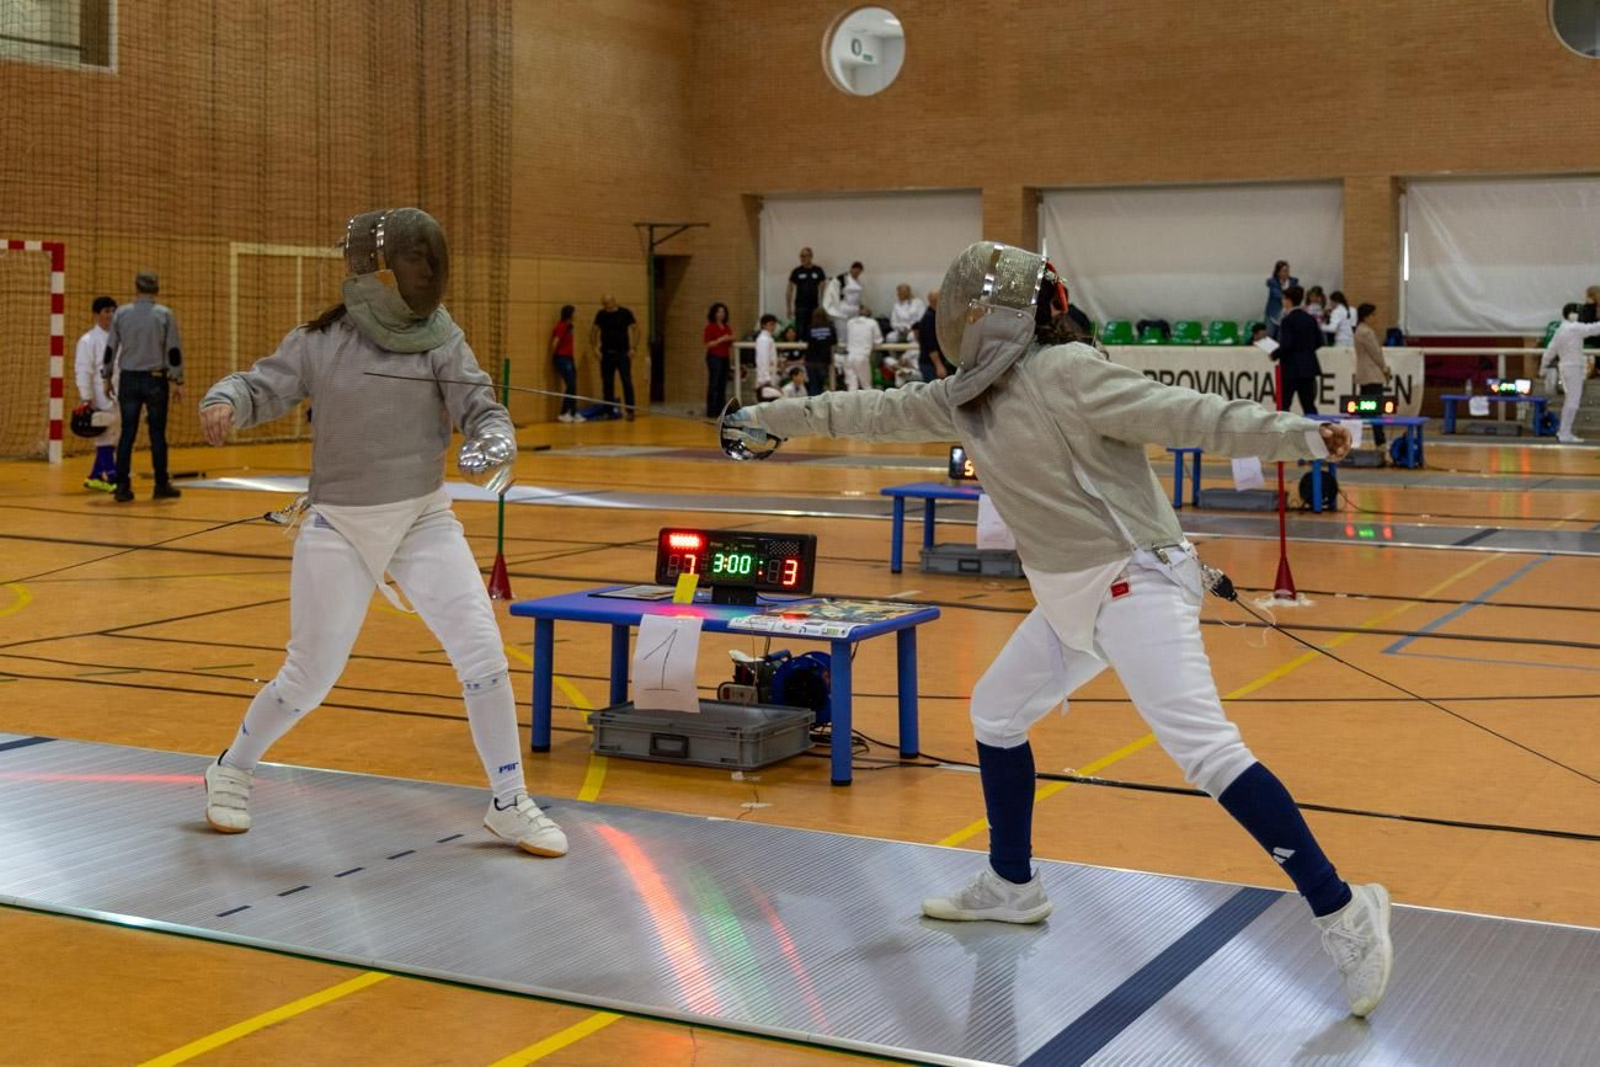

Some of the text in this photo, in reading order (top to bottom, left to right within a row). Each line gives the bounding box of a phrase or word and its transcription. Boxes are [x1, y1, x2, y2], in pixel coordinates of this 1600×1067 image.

[713, 553, 751, 574] 3:00
[783, 559, 798, 585] 3
[643, 628, 680, 693] 1
